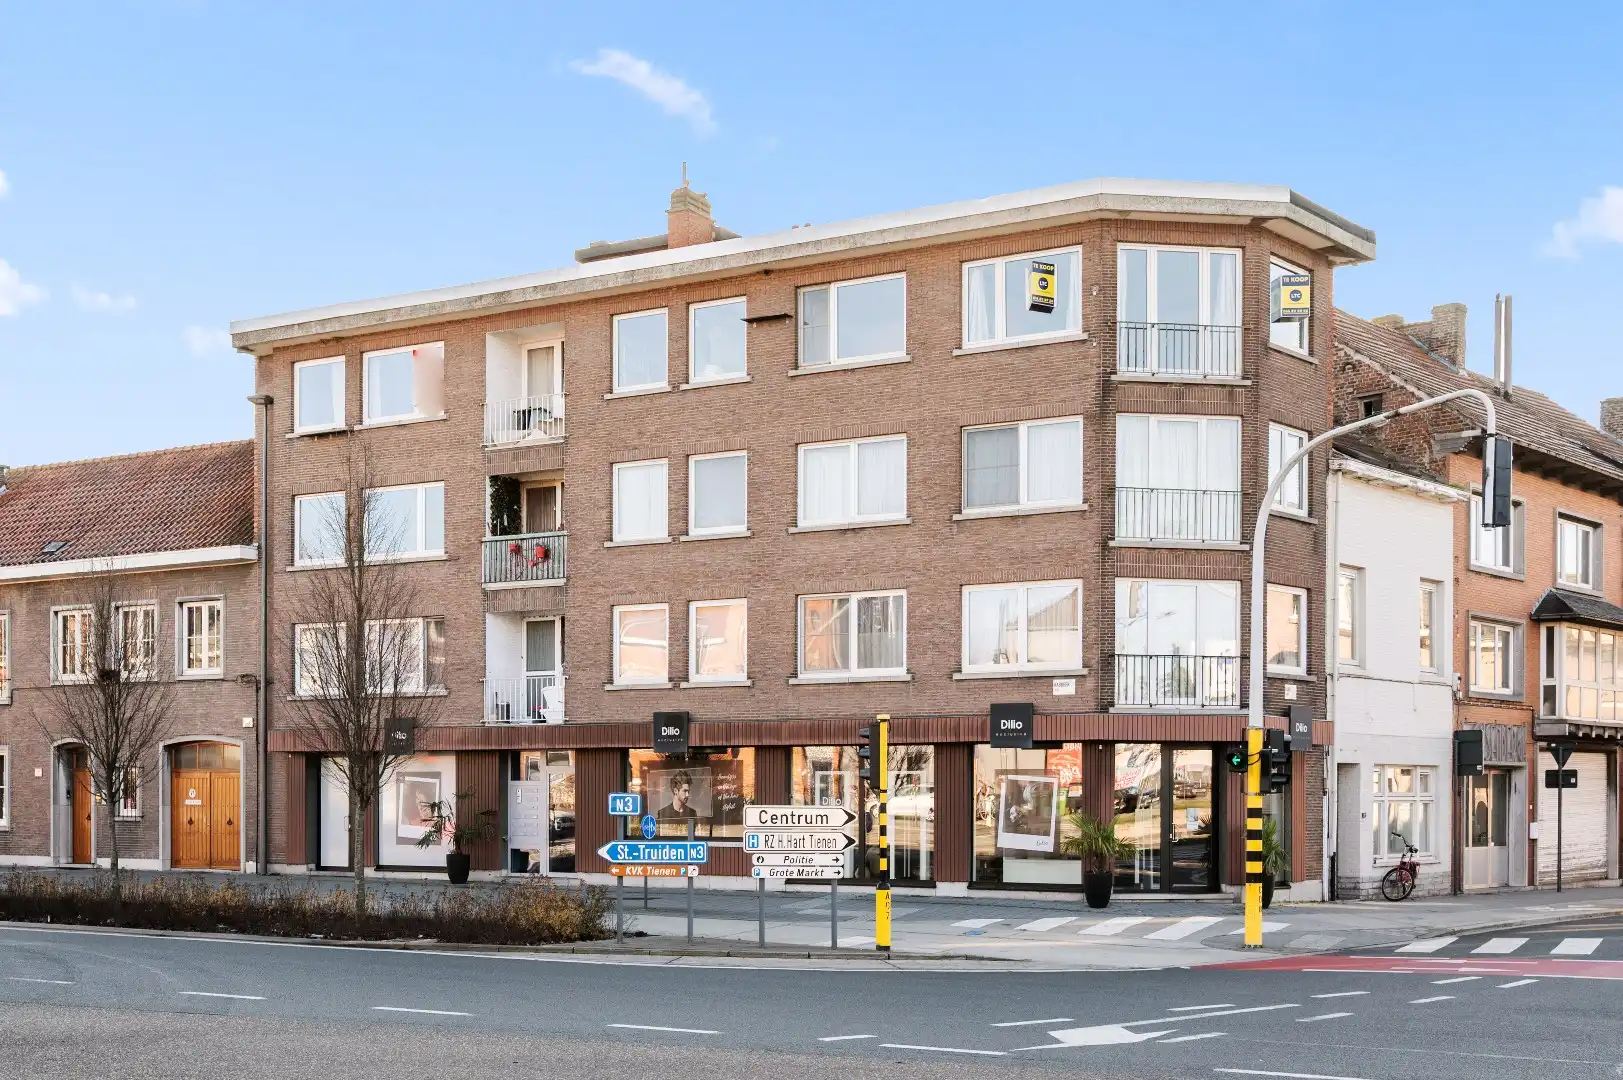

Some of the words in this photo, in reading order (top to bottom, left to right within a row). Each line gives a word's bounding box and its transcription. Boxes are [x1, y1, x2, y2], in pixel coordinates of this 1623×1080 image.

[1000, 719, 1023, 730] Dilio
[661, 726, 680, 736] Dilio
[616, 797, 633, 812] N3
[758, 810, 829, 825] Centrum
[764, 834, 775, 848] RZ
[777, 834, 806, 848] H.Hart
[808, 835, 837, 848] Tienen
[617, 845, 685, 860] St.-Truiden
[690, 846, 704, 859] N3
[783, 856, 814, 864] Politie
[625, 866, 643, 875] KVK
[646, 867, 677, 875] Tienen
[769, 868, 795, 877] Grote
[797, 868, 824, 877] Markt
